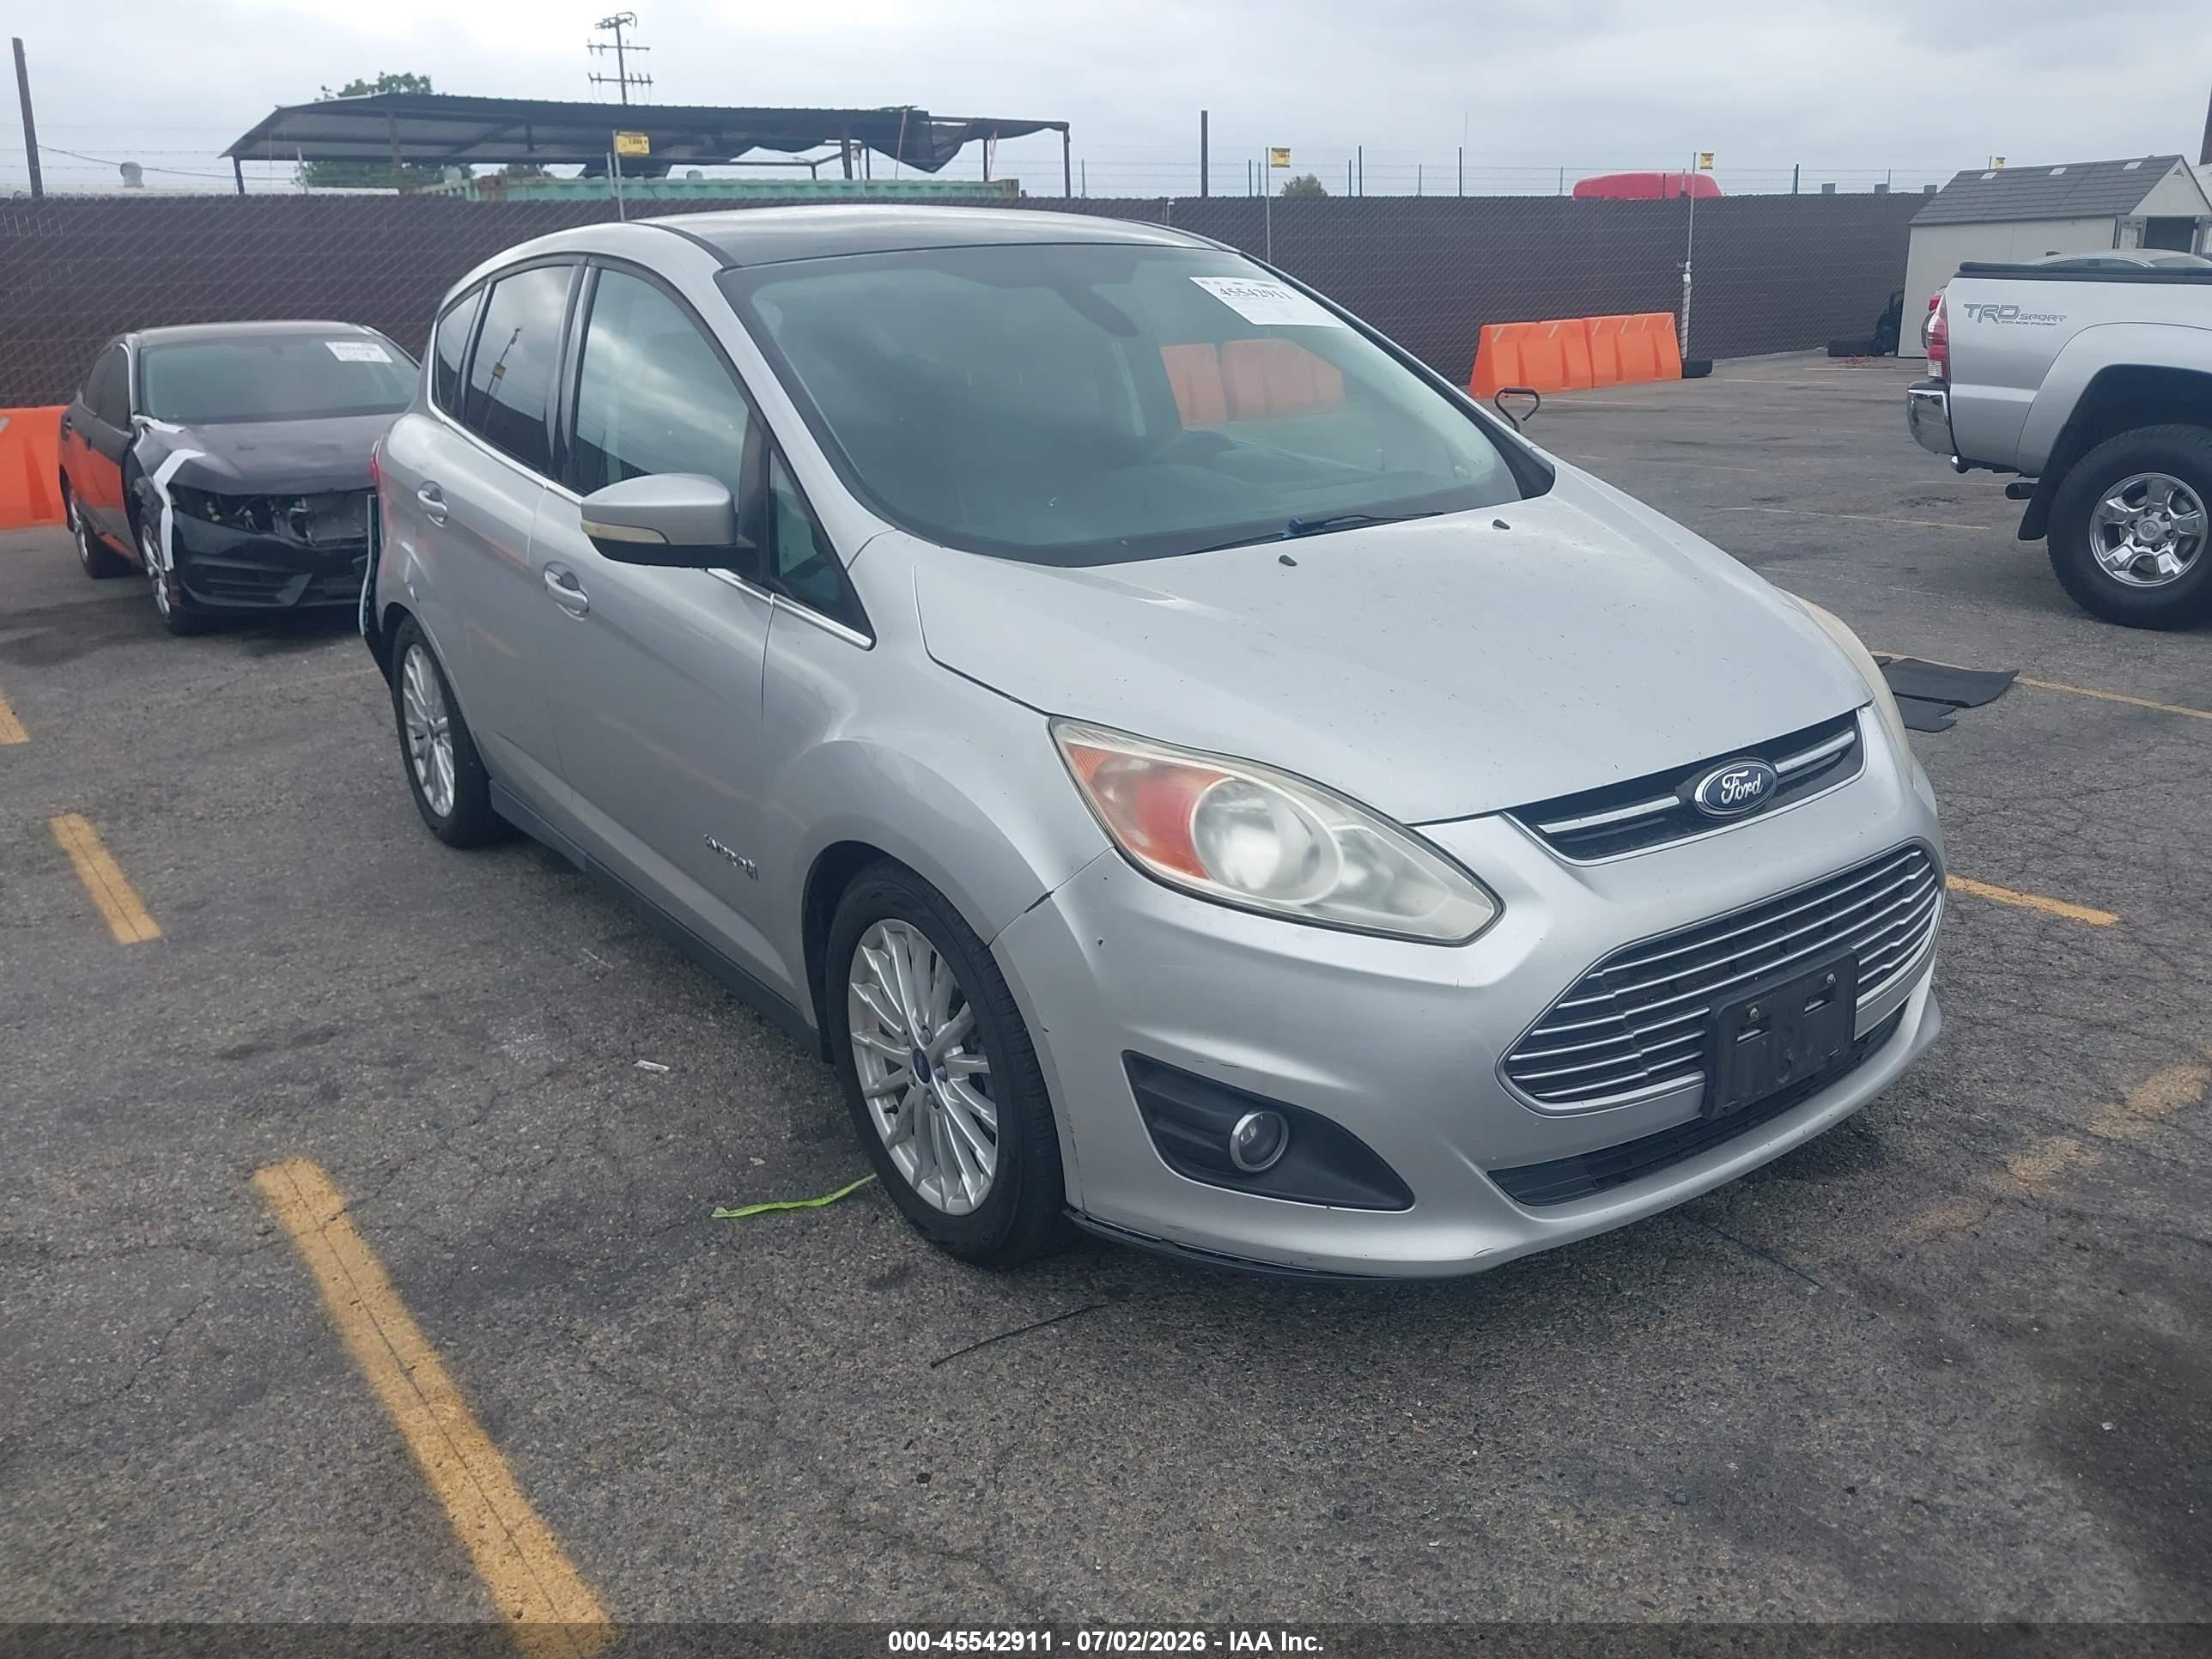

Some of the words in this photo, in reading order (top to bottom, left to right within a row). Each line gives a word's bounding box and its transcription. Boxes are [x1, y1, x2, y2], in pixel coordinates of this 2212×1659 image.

[1219, 288, 1292, 301] 45542911
[1963, 303, 2021, 325] TRD
[2020, 313, 2068, 323] SPORT
[1721, 769, 1764, 805] Ford
